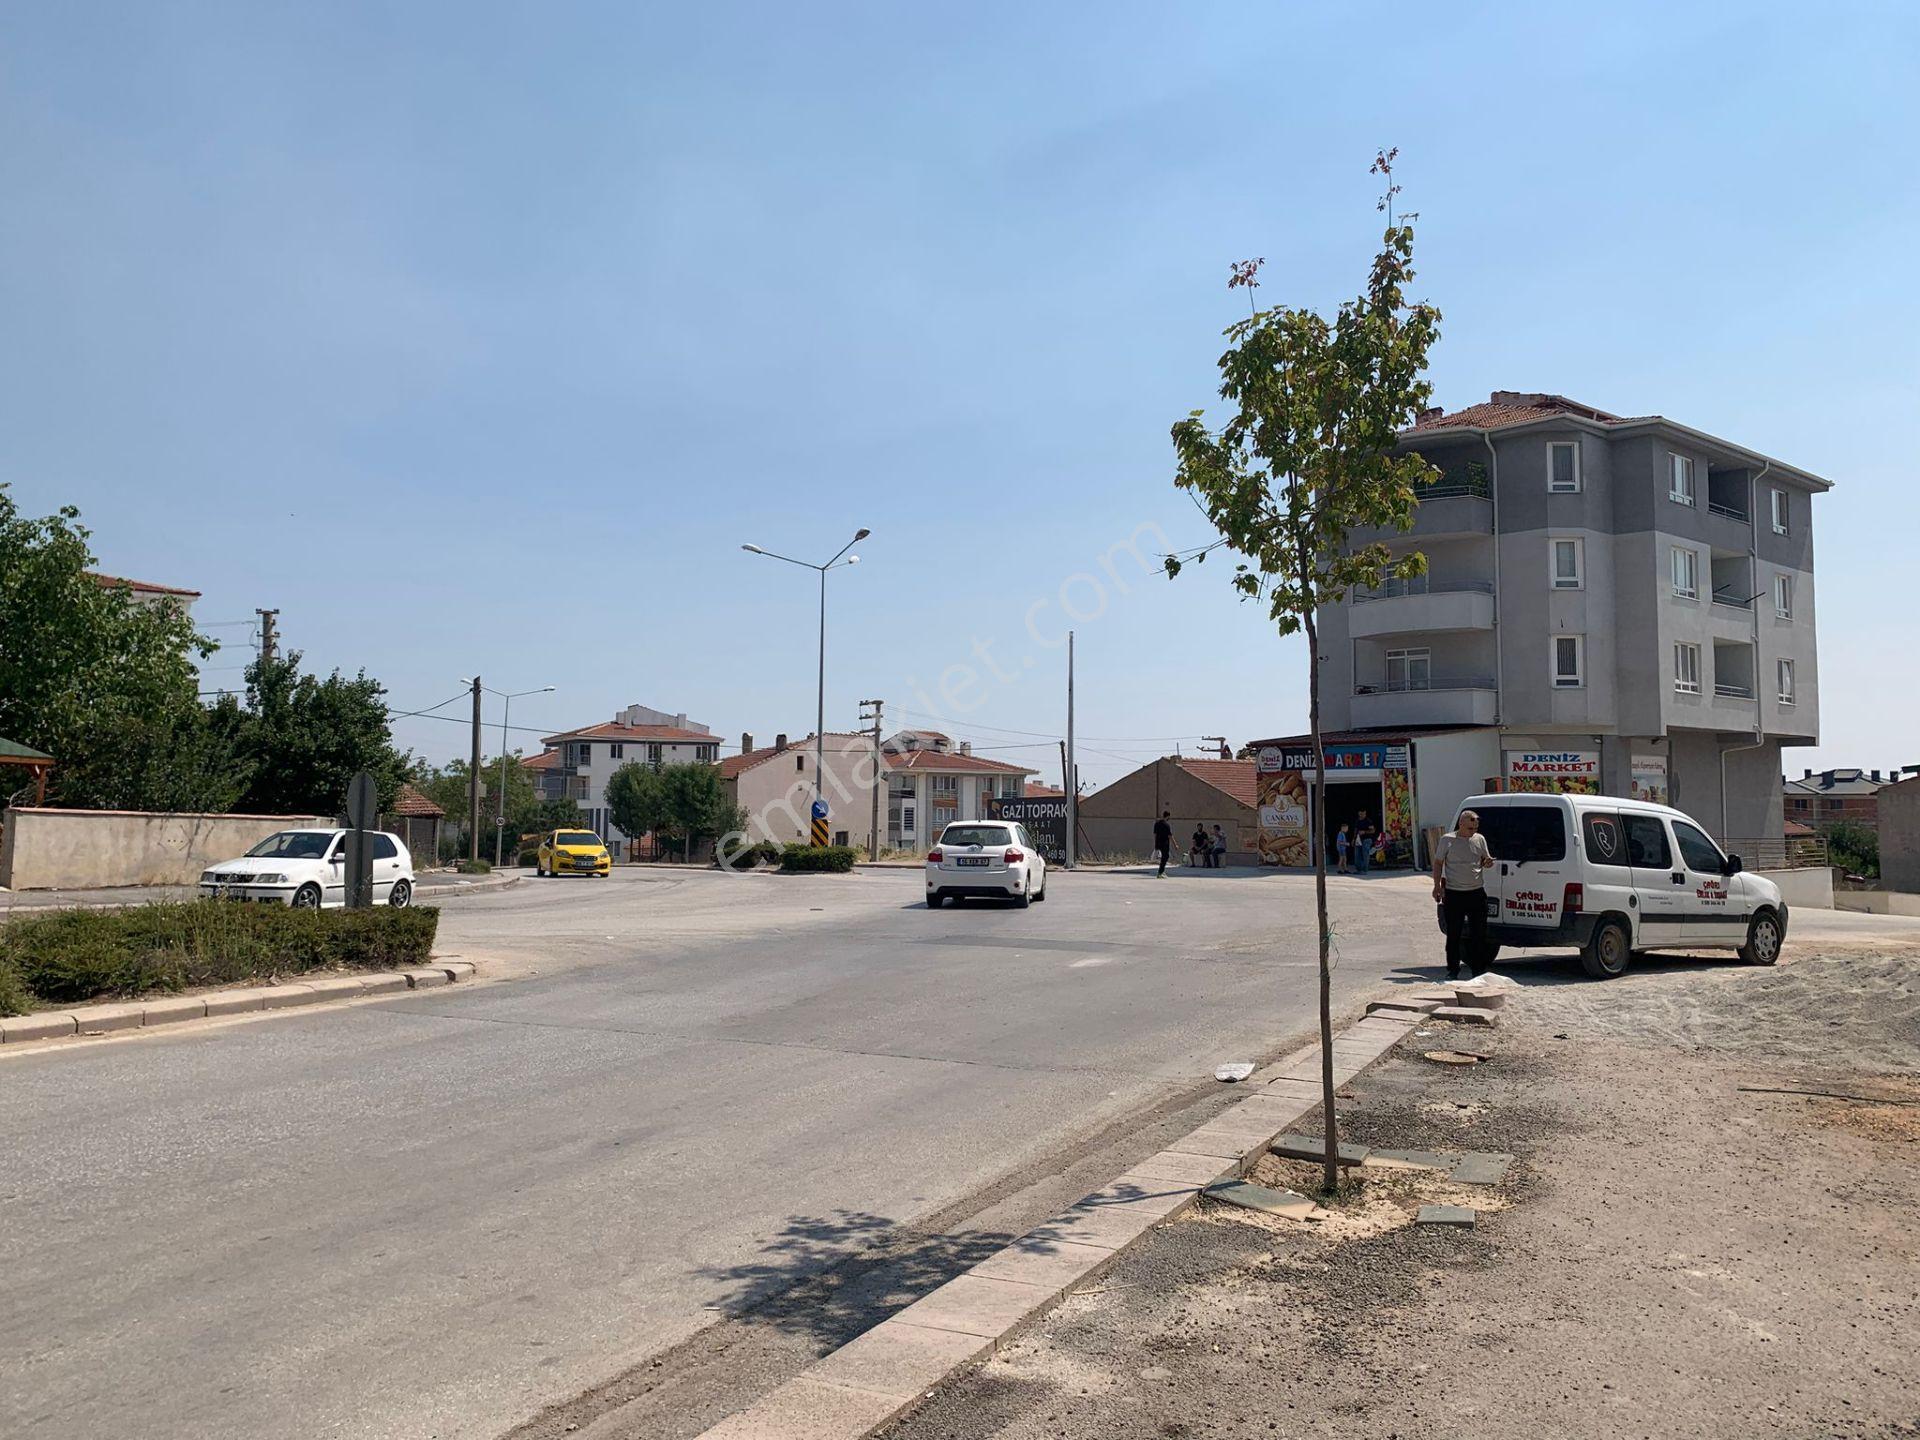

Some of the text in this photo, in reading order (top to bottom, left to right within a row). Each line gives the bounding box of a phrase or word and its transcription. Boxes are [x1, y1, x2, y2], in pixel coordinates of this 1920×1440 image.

[1324, 752, 1379, 767] MARKET
[1512, 752, 1596, 773] DENİZ MARKET
[1002, 801, 1068, 819] GAZİ TOPRAK
